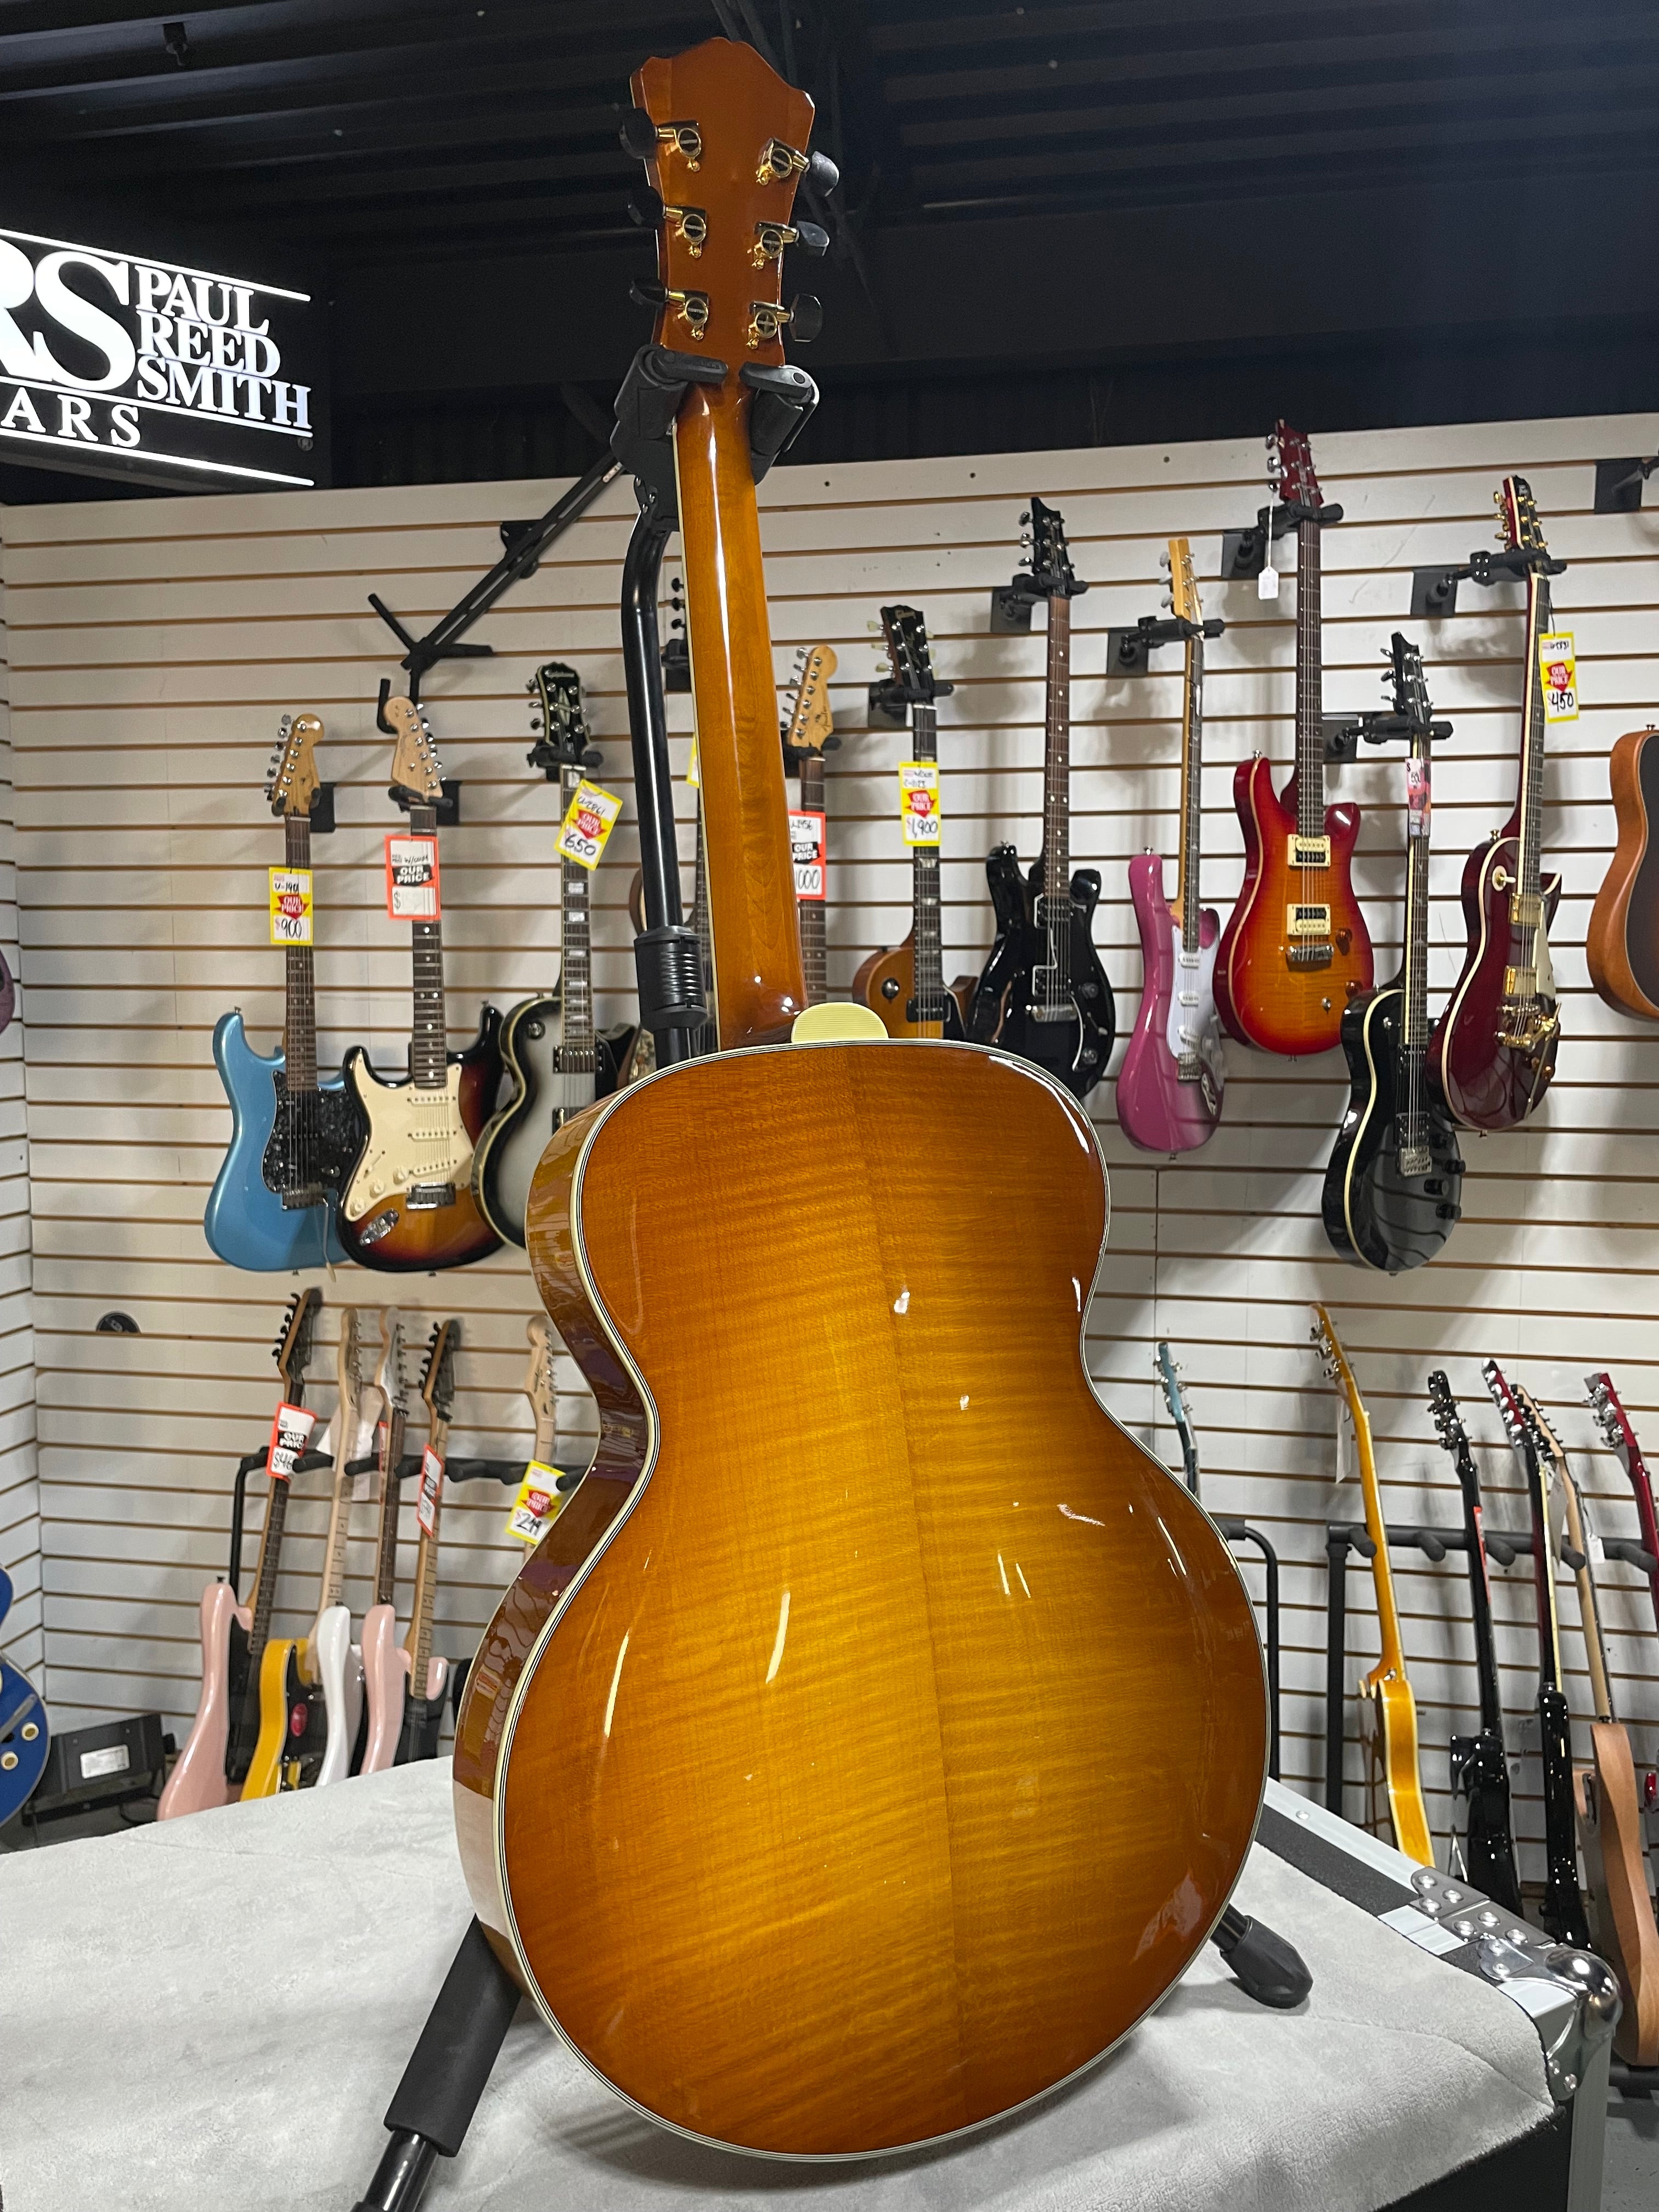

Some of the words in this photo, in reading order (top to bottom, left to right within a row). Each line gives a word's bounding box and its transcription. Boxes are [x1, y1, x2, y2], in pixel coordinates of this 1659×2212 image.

[135, 264, 269, 336] PAUL
[136, 309, 281, 378] REED
[137, 356, 312, 430] SMITH
[794, 843, 813, 852] OUR
[793, 850, 817, 861] PRICE
[400, 865, 424, 875] OUR
[397, 872, 430, 884] PRICE
[279, 1438, 304, 1449] PRIC
